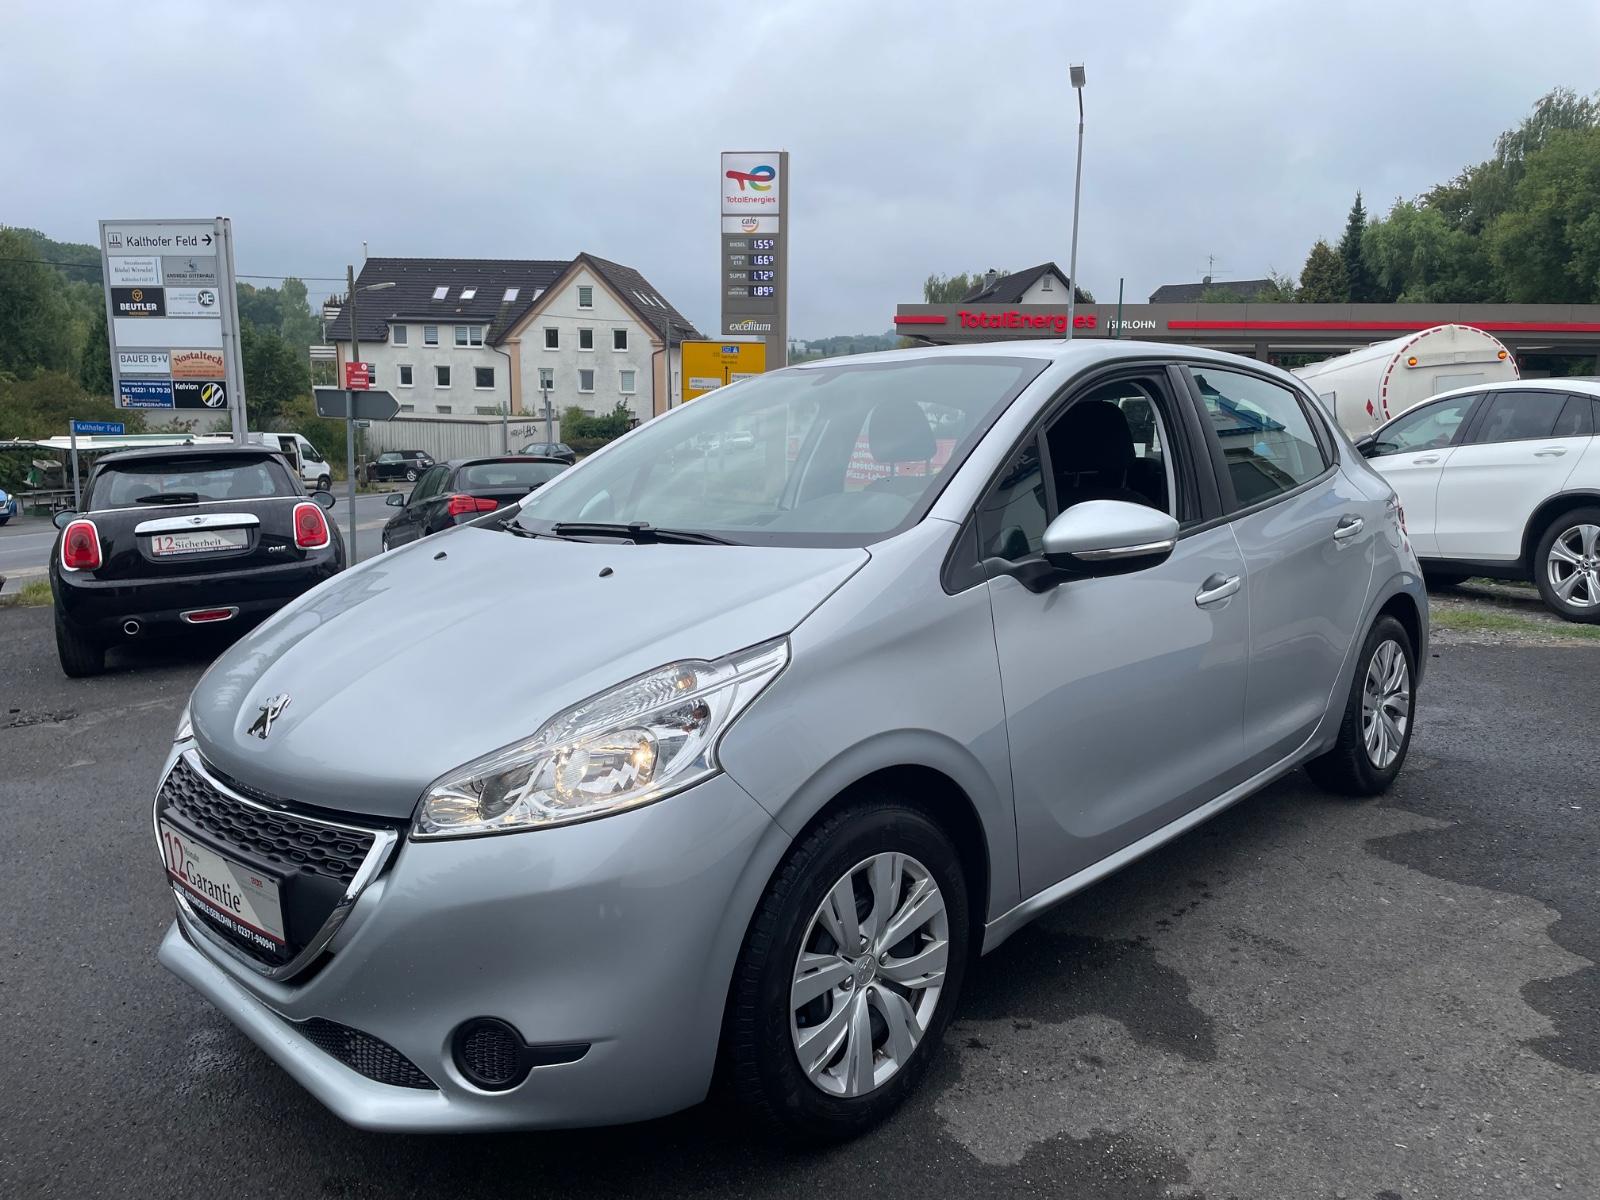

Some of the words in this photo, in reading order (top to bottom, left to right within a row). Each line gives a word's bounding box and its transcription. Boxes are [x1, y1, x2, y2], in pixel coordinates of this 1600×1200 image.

[726, 196, 776, 204] TotalEnergies
[126, 235, 172, 247] Kalthofer
[175, 235, 198, 247] Feld
[119, 302, 158, 311] BEUTLER
[729, 320, 771, 331] excellium
[957, 311, 1097, 333] TotalEnerges
[120, 354, 149, 363] BAUER
[151, 354, 168, 363] B+V
[173, 350, 223, 366] Nostaltech
[174, 382, 199, 390] Kelvion
[76, 423, 105, 431] Kalthofer
[154, 536, 175, 552] 12
[175, 539, 222, 549] Sicherheit
[268, 545, 287, 554] ONE
[164, 831, 188, 881] 12
[186, 860, 241, 913] Garantie
